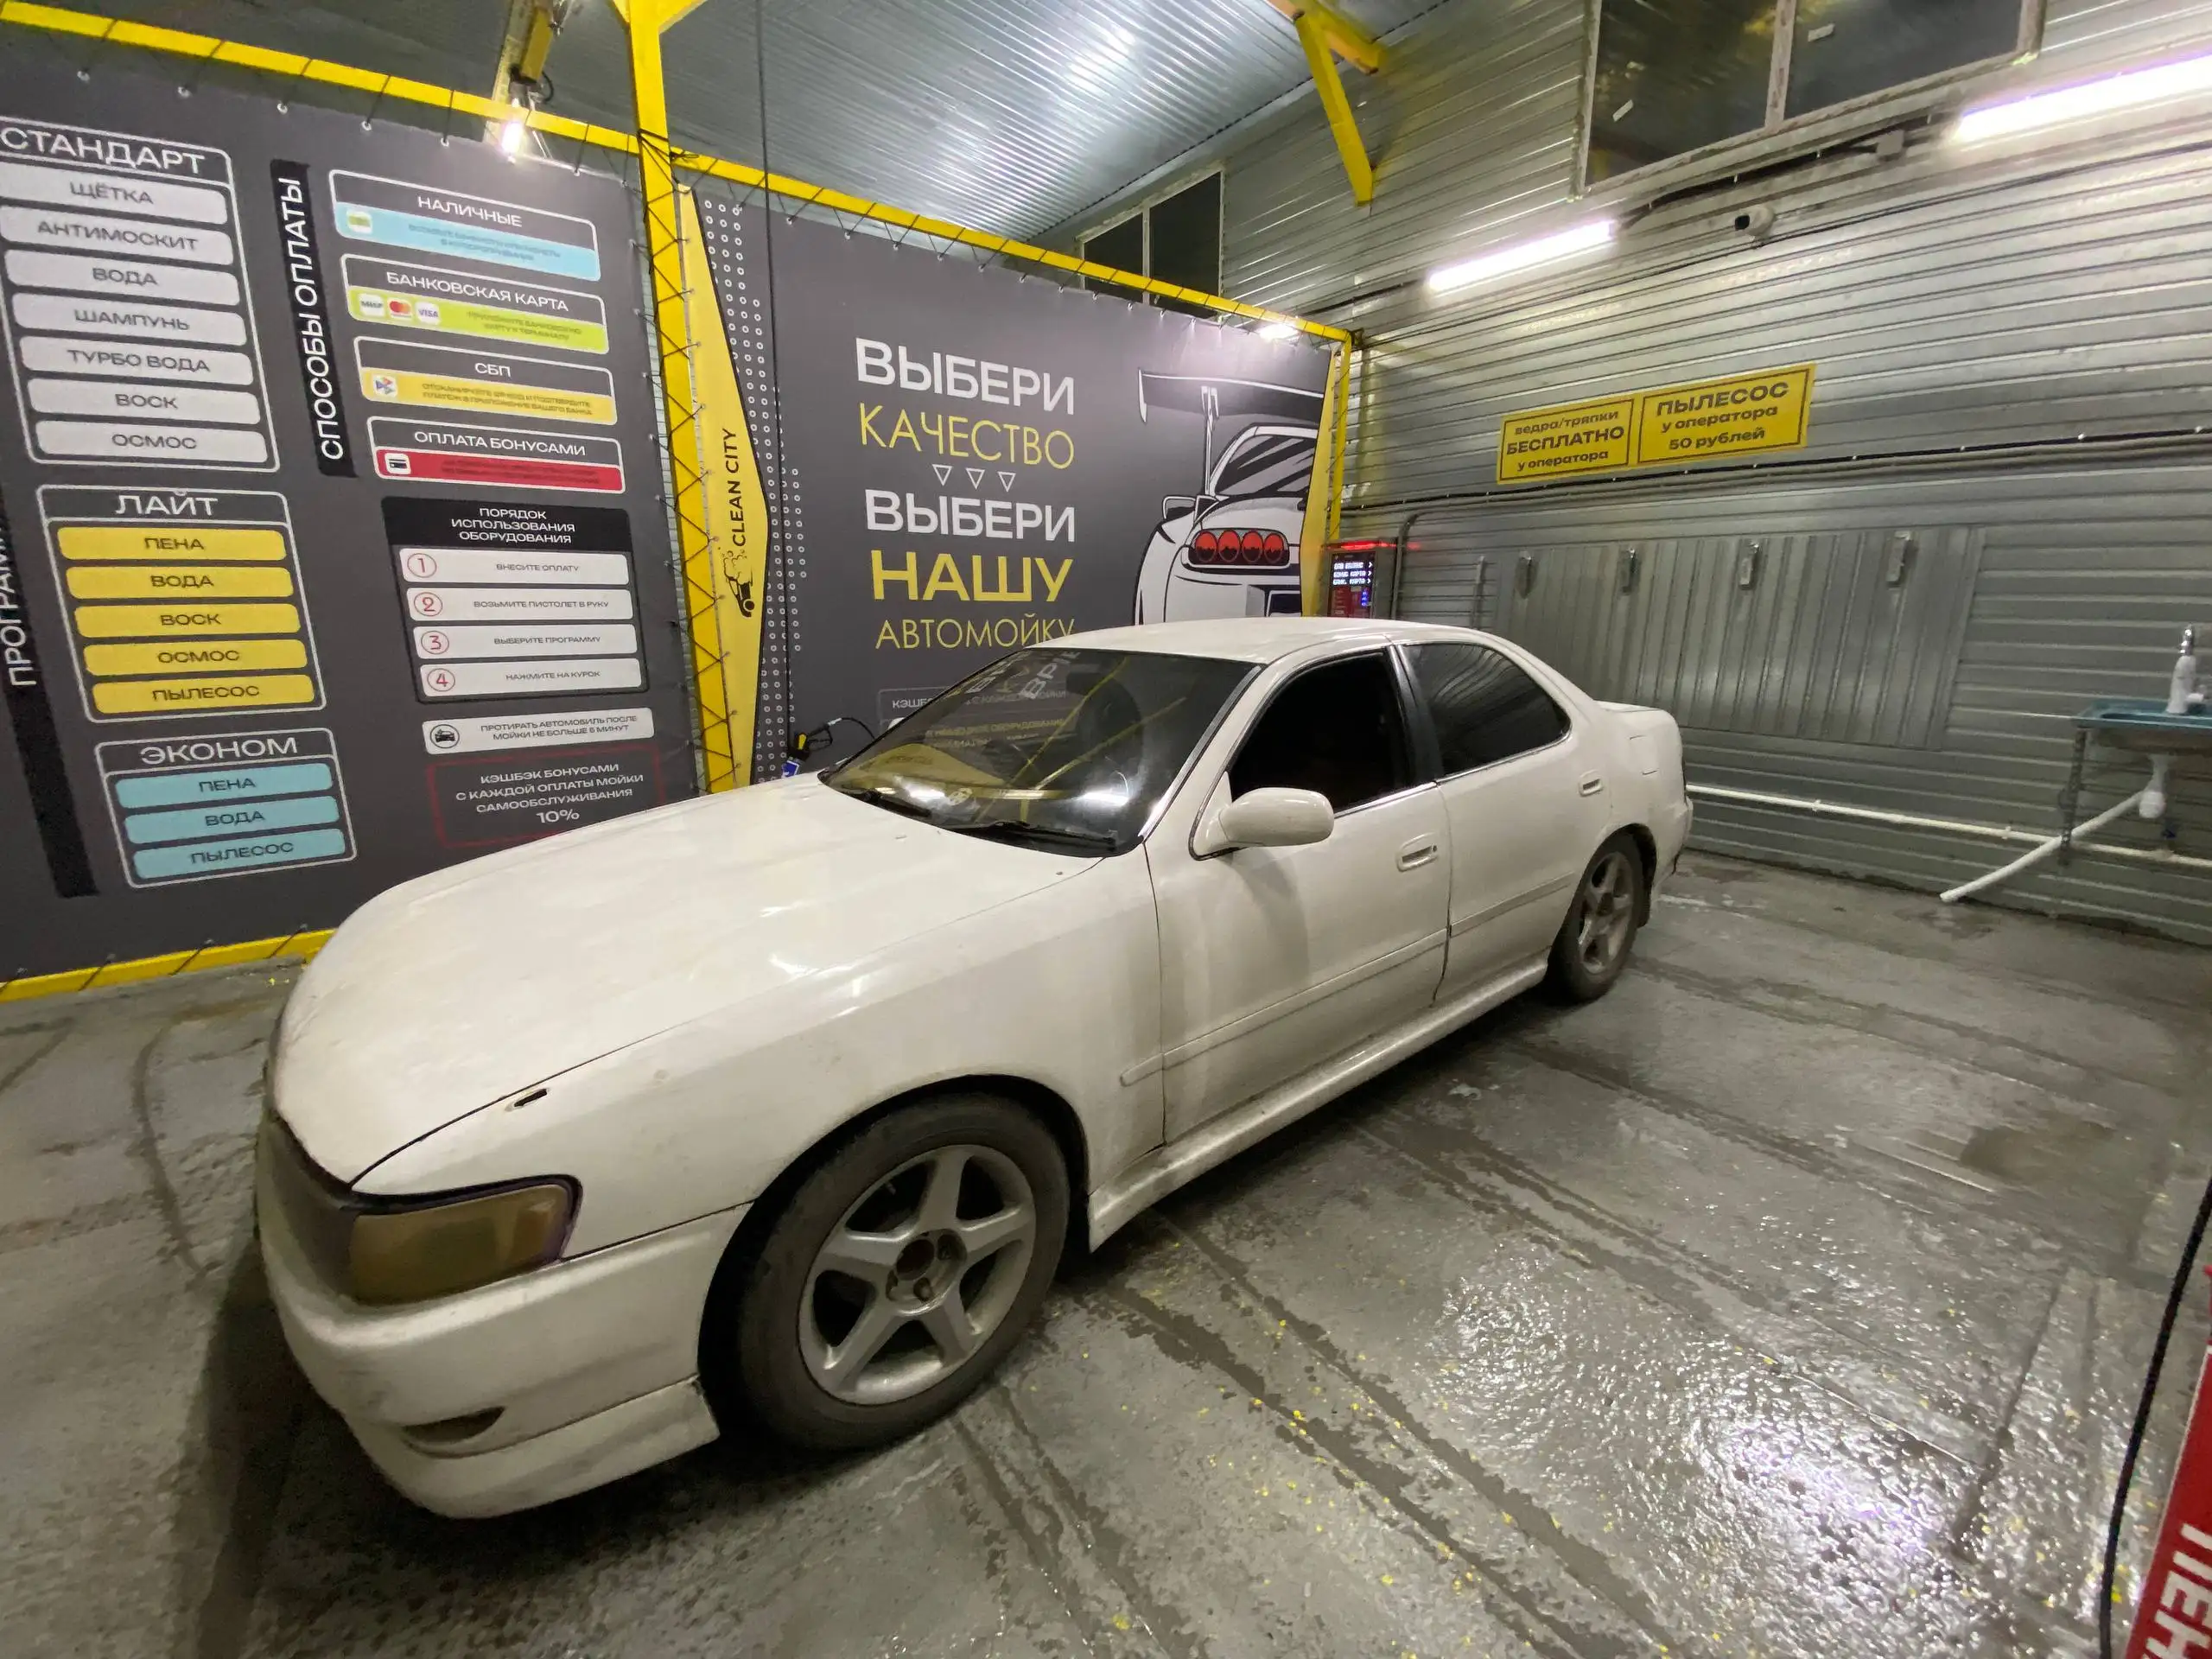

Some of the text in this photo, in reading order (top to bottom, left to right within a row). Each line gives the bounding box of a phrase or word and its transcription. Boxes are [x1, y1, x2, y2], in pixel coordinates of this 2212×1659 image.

[1, 128, 205, 173] СТАНДАРТ
[70, 181, 154, 204] ЩЁТКА
[417, 196, 522, 227] НАЛИЧНЫЕ
[38, 220, 198, 251] АНТИМОСКИТ
[92, 268, 158, 286] ВОДА
[386, 272, 569, 312] БАНКОВСКАЯ КАРТА
[75, 309, 189, 331] ШАМПУНЬ
[279, 178, 344, 460] СПОСОБЫ ОПЛАТЫ
[67, 350, 210, 372] ТУРБО ВОДА
[475, 363, 511, 378] СБП
[855, 337, 1074, 415] ВЫБЕРИ
[115, 393, 179, 409] ВОСК
[1656, 381, 1789, 416] ПЫЛЕСОС
[1515, 410, 1619, 435] ведра/тряпки
[1662, 406, 1778, 433] у оператора
[111, 434, 197, 449] ОСМОС
[414, 431, 586, 456] ОПЛАТА БОНУСАМИ
[860, 403, 1074, 469] КАЧЕСТВО
[1507, 426, 1624, 455] БЕСПЛАТНО
[1669, 427, 1765, 451] 50 рублей
[1517, 449, 1608, 472] у оператора
[722, 428, 747, 547] CLEAN CITY
[115, 493, 218, 516] ЛАЙТ
[480, 508, 547, 519] ПОРЯДОК
[451, 518, 575, 532] ИСПОЛЬЗОВАНИЯ
[865, 489, 1075, 543] ВЫБЕРИ
[144, 537, 205, 550] ПЕНА
[460, 531, 572, 543] ОБОРУДОВАНИЯ
[418, 558, 426, 573] 1
[871, 550, 1073, 602] НАШУ
[151, 575, 214, 588] ВОДА
[422, 597, 435, 612] 2
[161, 613, 221, 626] ВОСК
[429, 635, 442, 650] 3
[157, 650, 239, 664] ОСМОС
[435, 673, 448, 687] 4
[152, 685, 259, 701] ПЫЛЕСОС
[480, 723, 538, 732] ПРОТИРАТЬ
[538, 718, 606, 728] АВТОМОБИЛЬ
[493, 731, 531, 741] МОЙКИ
[596, 724, 629, 733] МИНУТ
[140, 737, 297, 765] ЭКОНОМ
[480, 764, 620, 784] КЭШБЭК БОНУСАМИ
[199, 778, 257, 793] ПЕНА
[456, 774, 644, 801] С КАЖДОЙ ОПЛАТЫ МОЙКИ
[476, 788, 632, 813] САМООБСЛУЖИВАНИЯ
[206, 811, 265, 826] ВОДА
[536, 809, 580, 823] 10%
[190, 842, 294, 865] ПЫЛЕСОС
